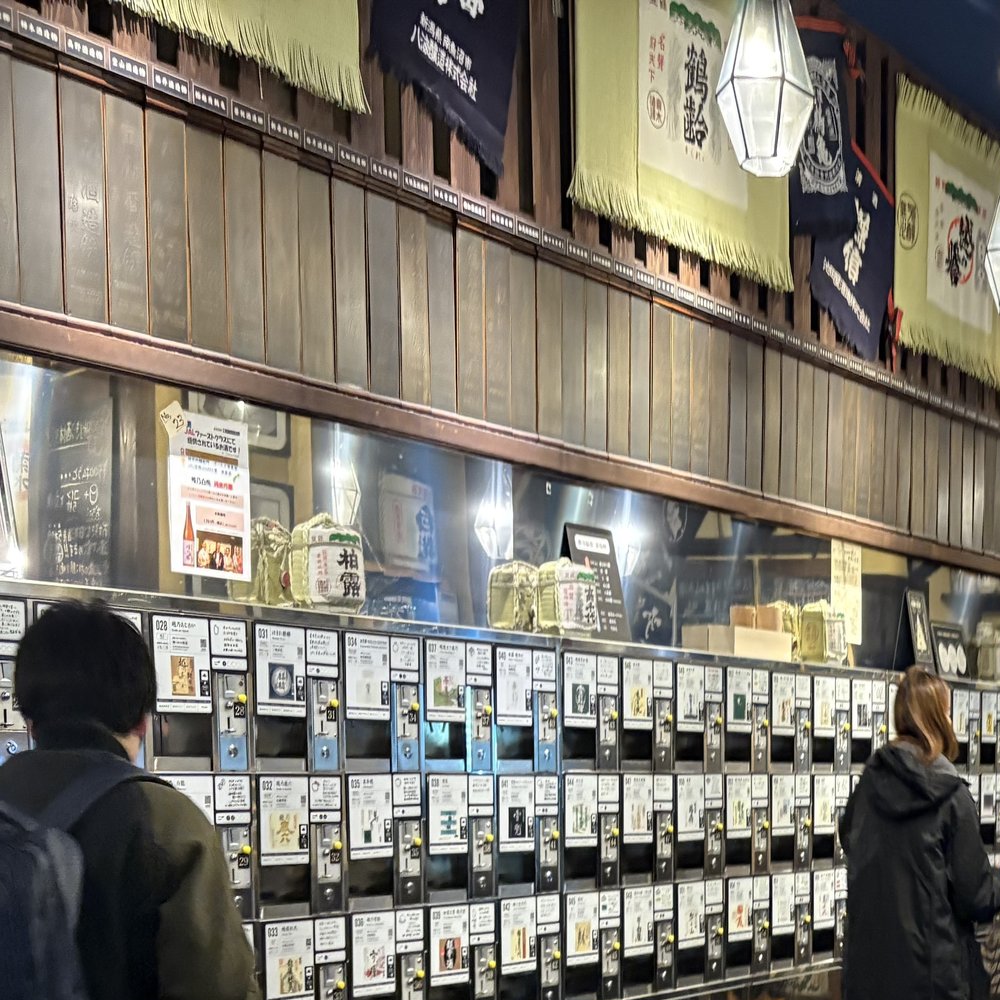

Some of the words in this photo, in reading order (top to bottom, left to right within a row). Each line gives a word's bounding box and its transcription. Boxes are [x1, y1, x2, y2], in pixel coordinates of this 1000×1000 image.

[410, 24, 477, 102] 八海醸造株式会社
[337, 547, 361, 598] 柏露
[156, 620, 168, 632] 028
[258, 628, 268, 639] 031
[262, 780, 273, 791] 032
[268, 927, 278, 937] 033
